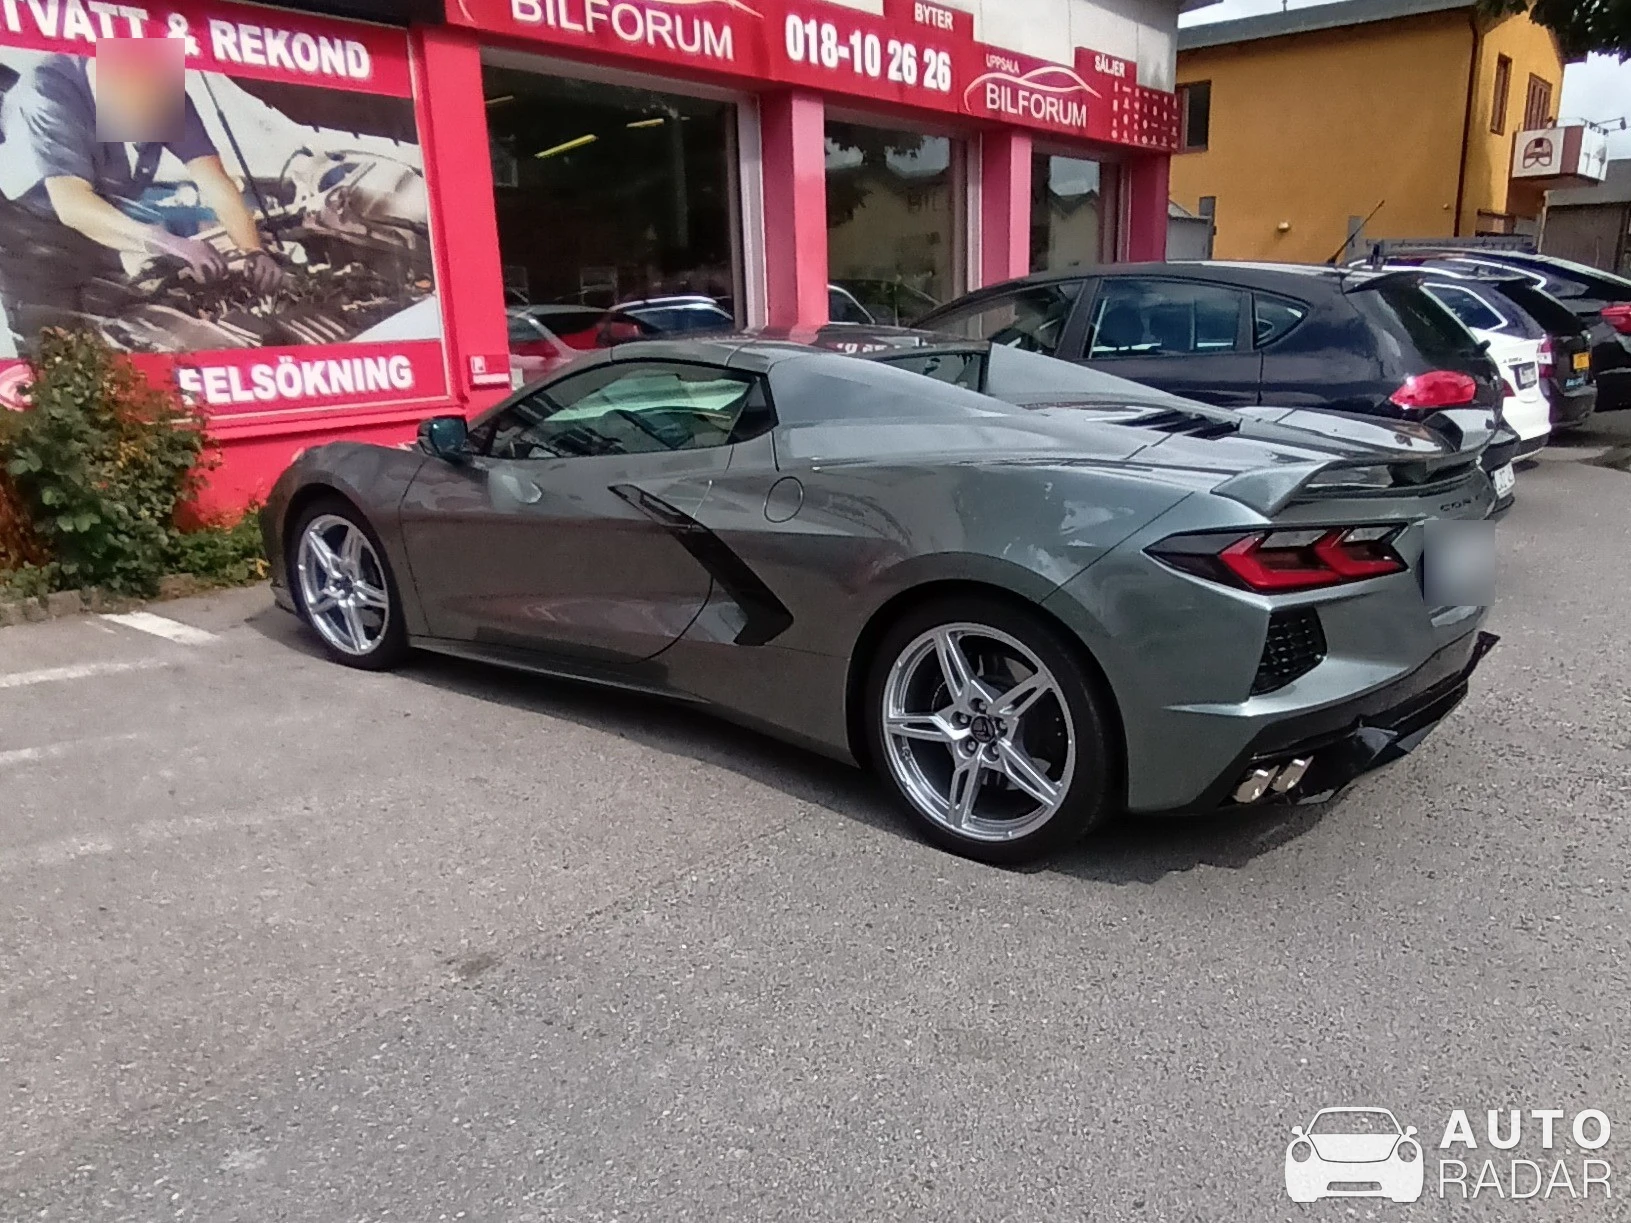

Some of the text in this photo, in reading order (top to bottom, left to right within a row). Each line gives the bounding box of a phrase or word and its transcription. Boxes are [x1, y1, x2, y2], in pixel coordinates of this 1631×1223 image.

[511, 0, 734, 61] BILFORUM
[914, 2, 954, 31] BYTER
[167, 12, 201, 56] &
[209, 18, 371, 79] REKOND
[785, 14, 952, 92] 018-10 26 26
[986, 53, 1020, 75] UPPSALA
[1094, 55, 1126, 78] SÄLJER
[986, 82, 1087, 128] BILFORUM
